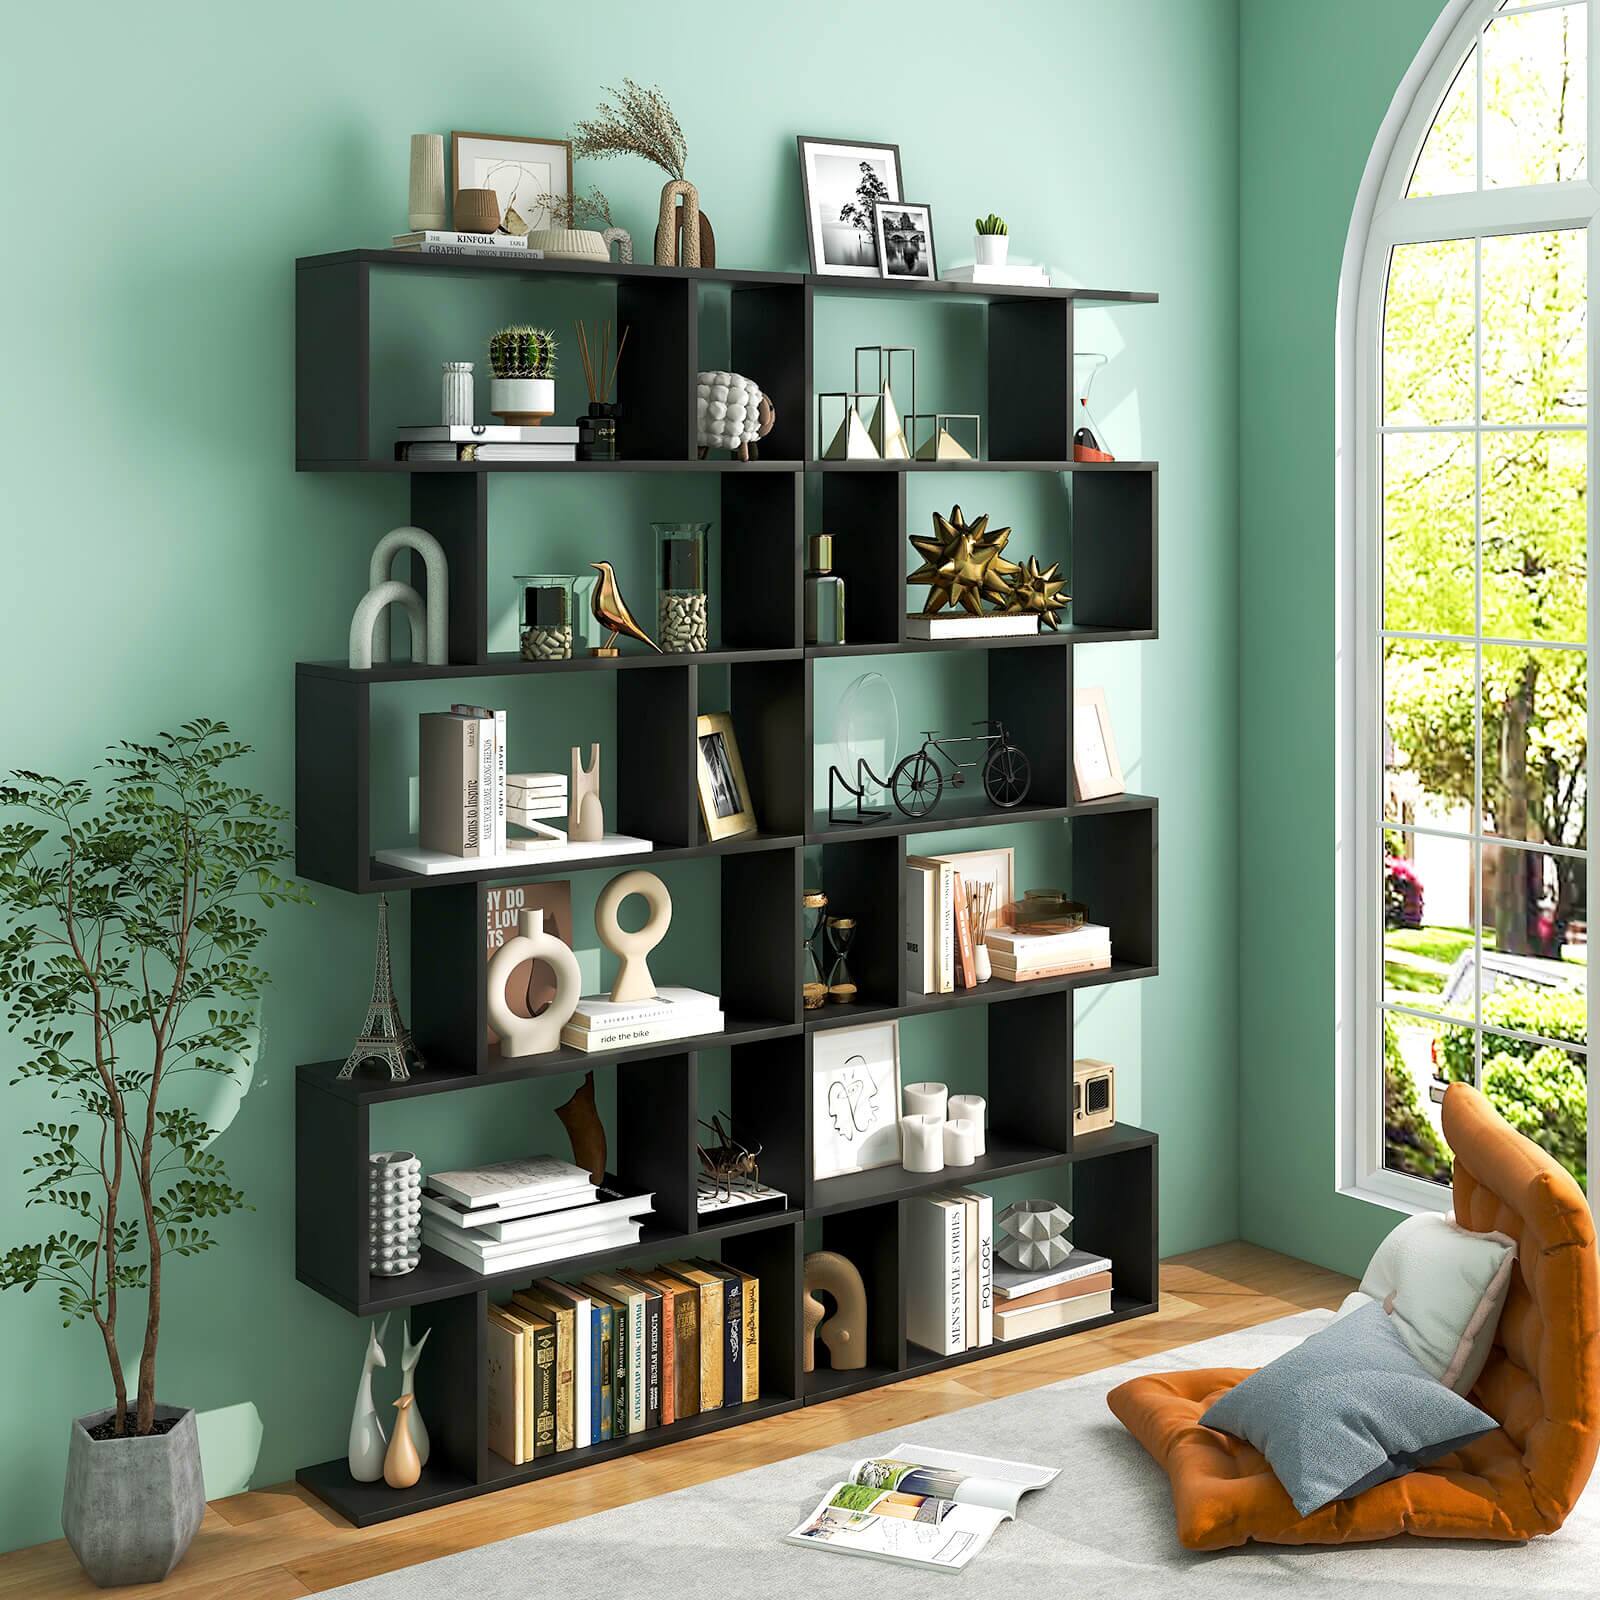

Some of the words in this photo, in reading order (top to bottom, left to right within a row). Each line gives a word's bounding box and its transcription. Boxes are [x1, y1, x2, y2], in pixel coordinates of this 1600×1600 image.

[457, 235, 495, 245] KINFOLK
[429, 245, 465, 256] GRAPHIC
[483, 739, 492, 764] FRIENDS
[483, 764, 492, 786] AMONG
[498, 775, 504, 787] BY
[464, 780, 479, 808] Inspire
[483, 788, 492, 806] HOME
[467, 809, 478, 818] to
[483, 806, 492, 823] YOUR
[464, 820, 478, 849] Rooms
[483, 823, 492, 840] MAKE
[506, 888, 525, 909] DO
[487, 929, 504, 949] TS
[601, 1034, 617, 1043] ride
[618, 1032, 632, 1040] the
[633, 1030, 650, 1038] bike
[951, 1211, 960, 1264] STORIES
[982, 1236, 991, 1309] POLLOCK
[951, 1265, 960, 1303] STYLE
[951, 1306, 960, 1344] MEN'S
